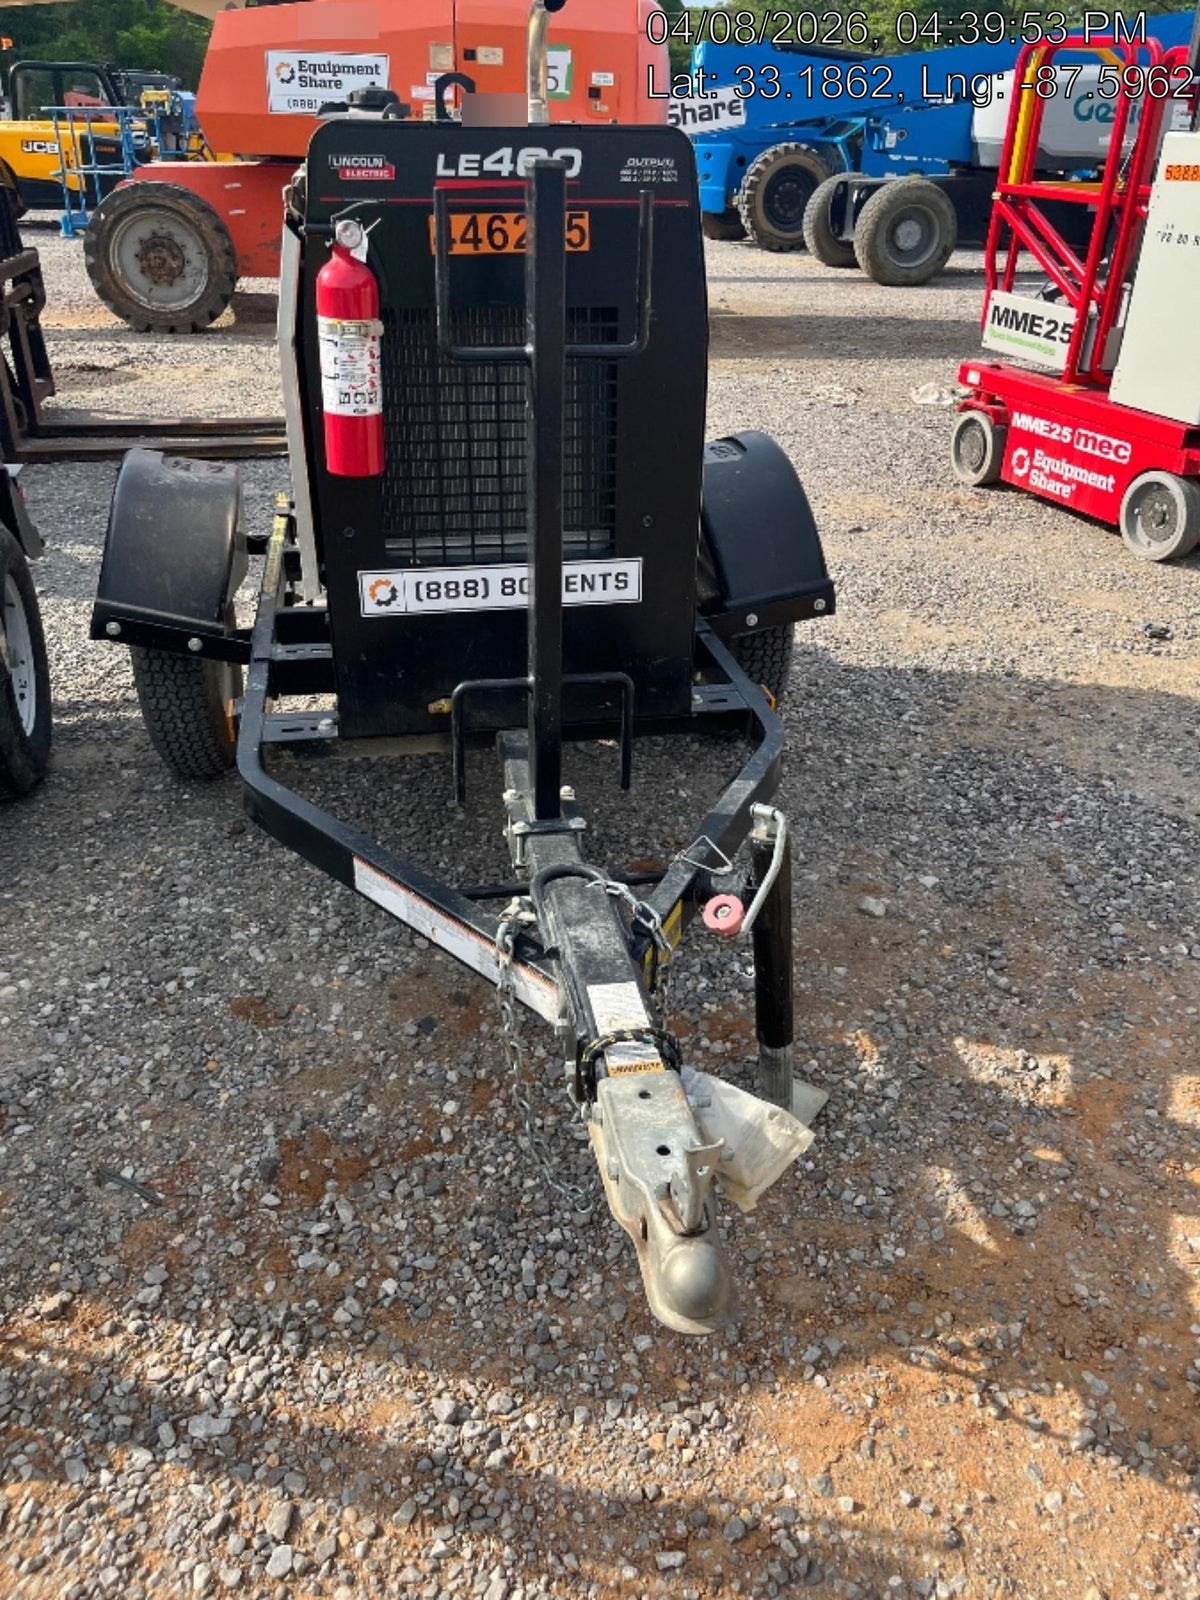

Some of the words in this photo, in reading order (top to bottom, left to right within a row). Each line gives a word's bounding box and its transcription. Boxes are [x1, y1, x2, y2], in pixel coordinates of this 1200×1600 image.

[297, 60, 381, 77] Equipment
[297, 76, 342, 89] Share
[668, 98, 742, 127] Share
[22, 140, 60, 155] JCB
[333, 156, 384, 168] LINCOLN
[345, 168, 391, 178] ELECTRIC
[990, 305, 1074, 344] MME25
[1011, 411, 1073, 444] MME25
[1074, 430, 1130, 463] mec
[1032, 448, 1115, 493] Equipment
[414, 579, 490, 602] (888)
